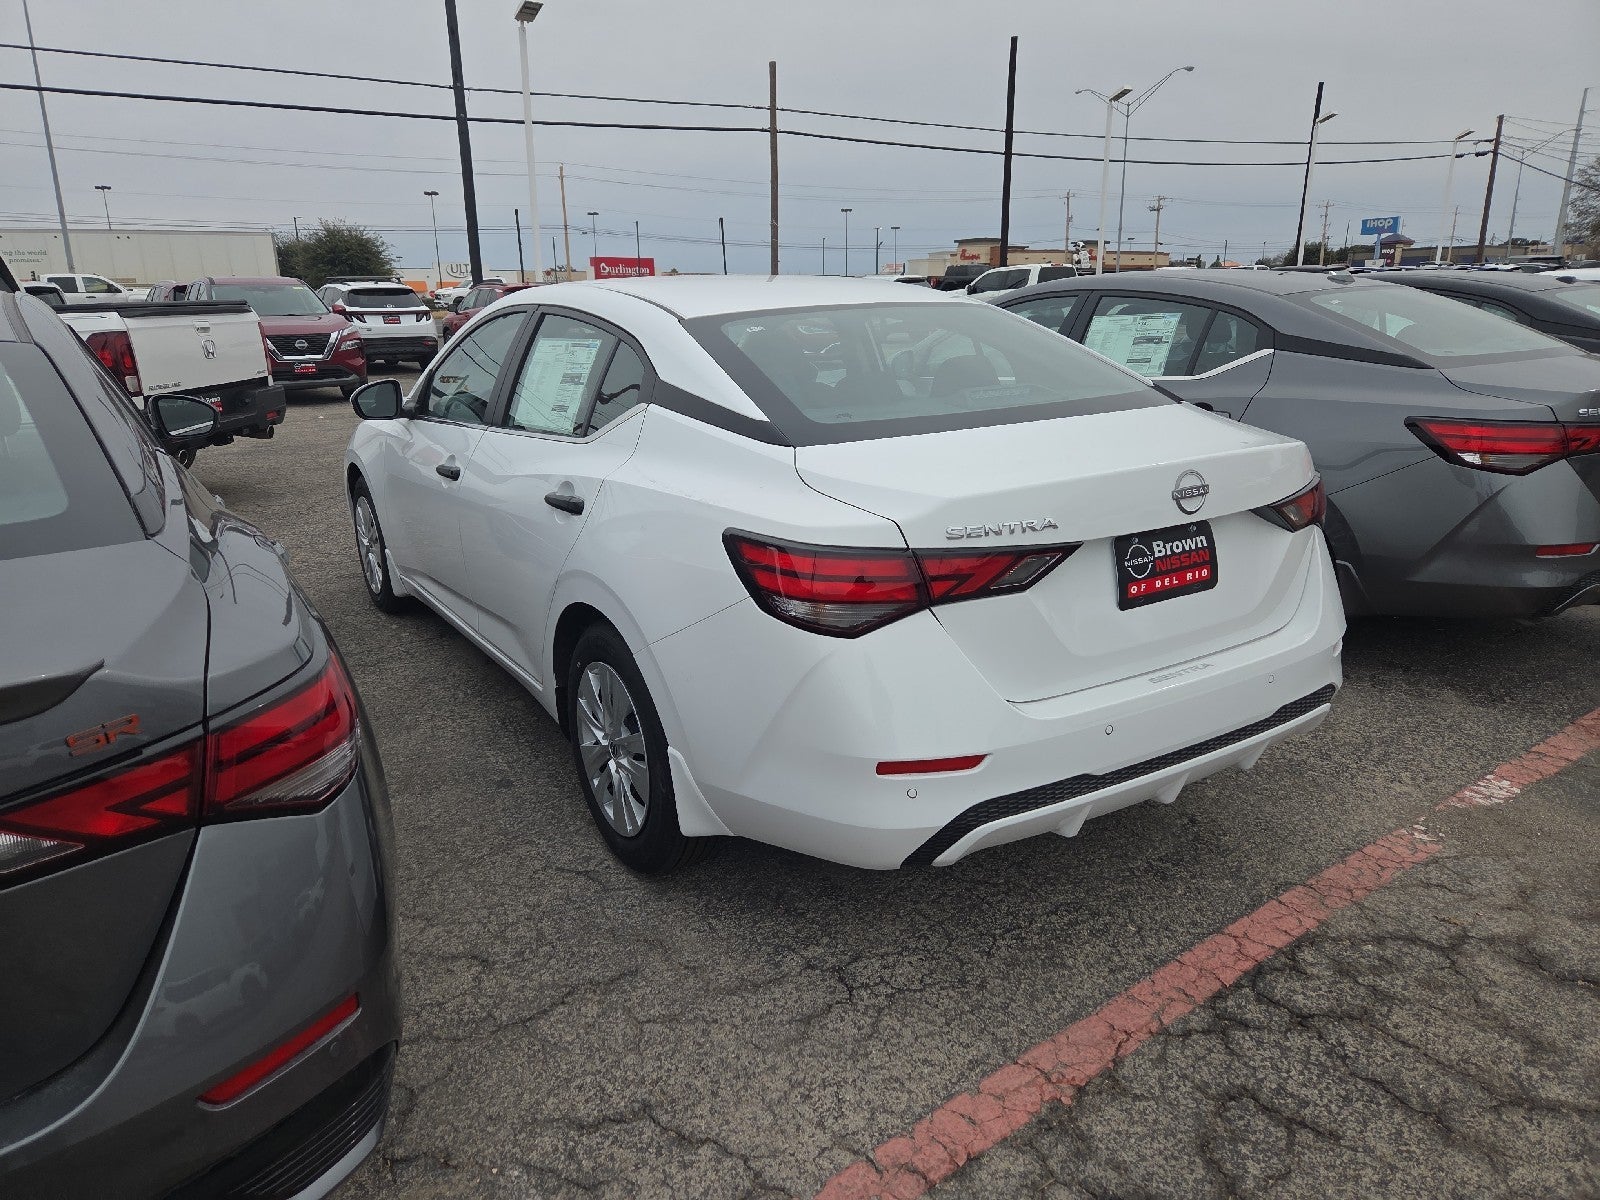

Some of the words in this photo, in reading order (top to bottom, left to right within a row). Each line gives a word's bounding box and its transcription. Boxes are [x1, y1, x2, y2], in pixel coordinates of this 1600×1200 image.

[450, 263, 472, 274] ULT
[600, 262, 650, 276] Burlington
[1173, 485, 1209, 499] NISSAN
[945, 517, 1059, 540] SENTRA
[1152, 535, 1208, 557] Brown
[1124, 555, 1154, 567] NISSAN
[1155, 549, 1210, 572] NISSAN
[1130, 583, 1147, 594] OF
[1155, 576, 1179, 588] DEL
[1186, 568, 1208, 580] RIO
[65, 713, 144, 757] SR
